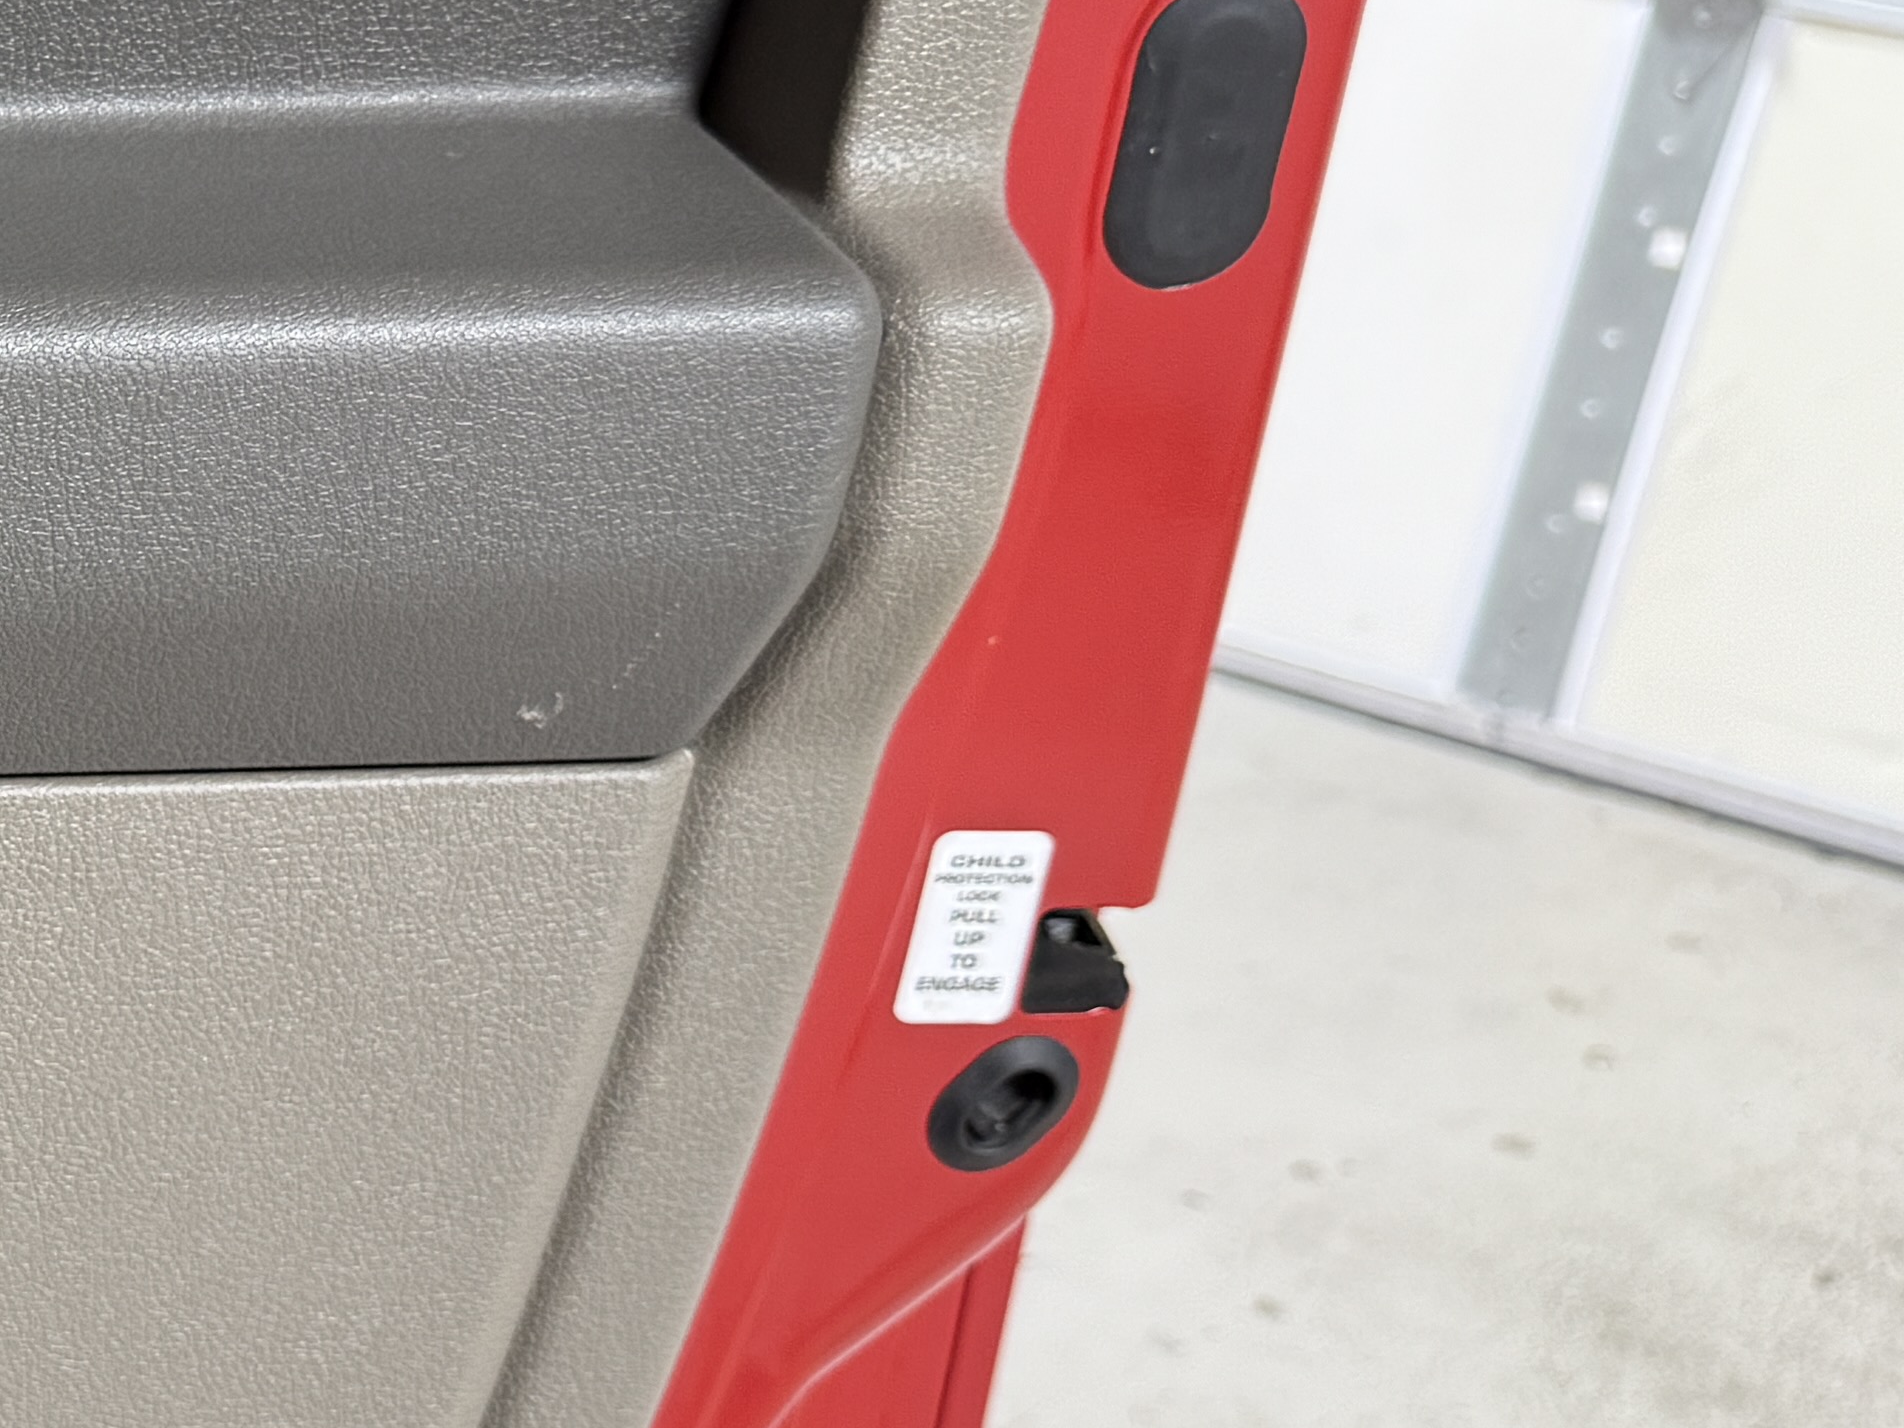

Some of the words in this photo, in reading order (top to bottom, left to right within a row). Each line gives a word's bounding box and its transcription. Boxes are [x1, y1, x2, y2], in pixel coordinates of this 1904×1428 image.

[950, 854, 1026, 868] CHILD
[934, 873, 1034, 885] PROTECTION
[956, 890, 1002, 902] LOCK
[948, 909, 1001, 923] PULL
[952, 931, 986, 947] UP
[949, 953, 978, 969] TO
[914, 976, 1002, 992] ENGAGE
